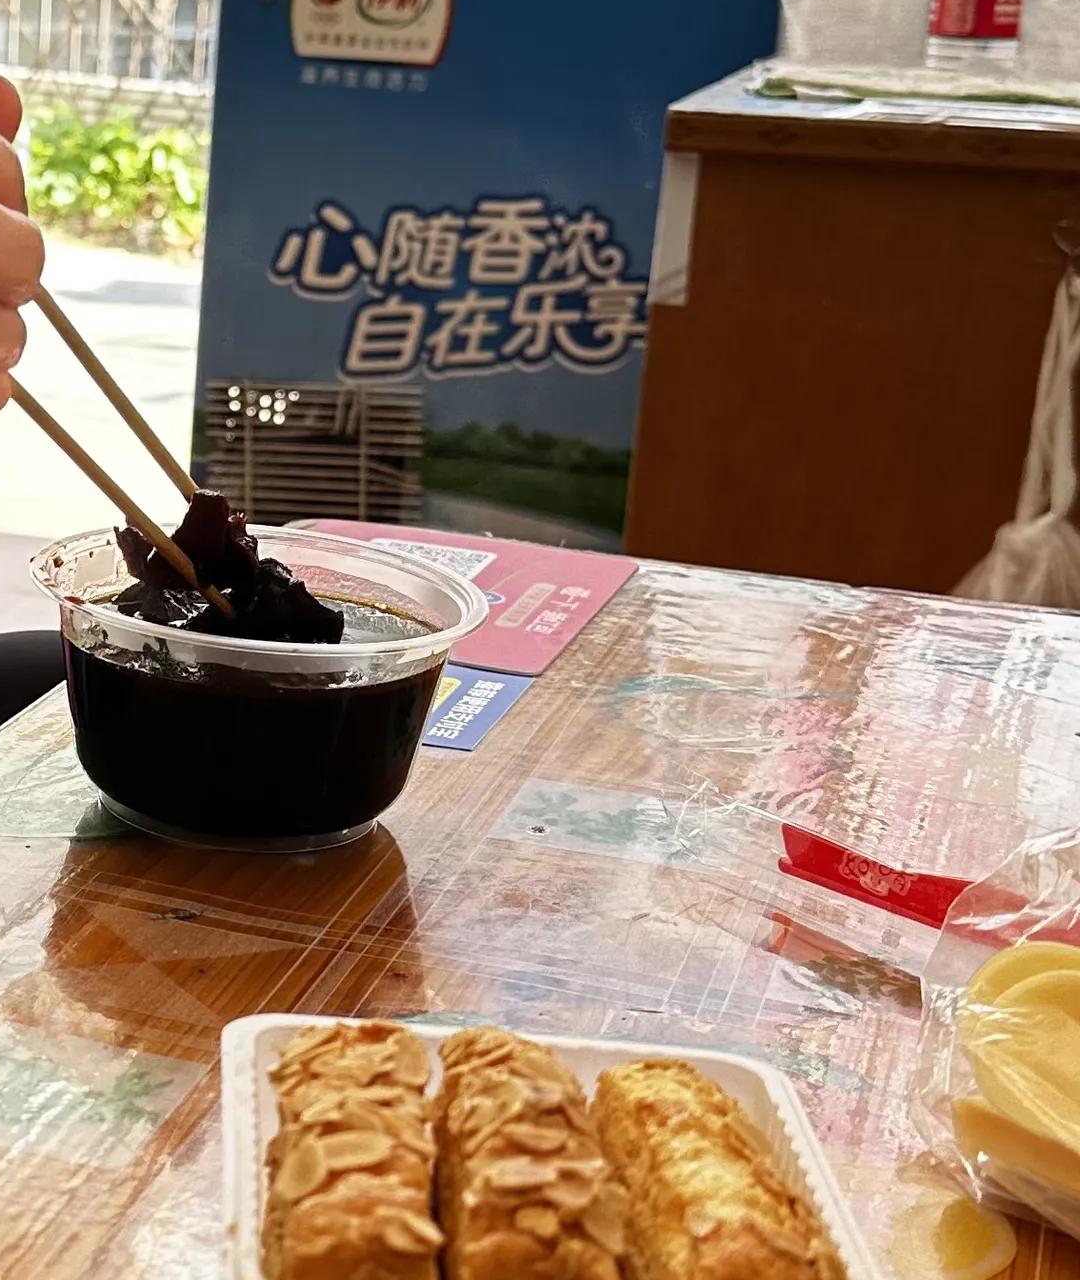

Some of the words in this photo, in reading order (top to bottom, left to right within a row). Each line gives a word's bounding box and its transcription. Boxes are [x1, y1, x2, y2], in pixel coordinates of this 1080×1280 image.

[273, 198, 626, 292] 心随香浓
[344, 275, 648, 374] 自在乐享
